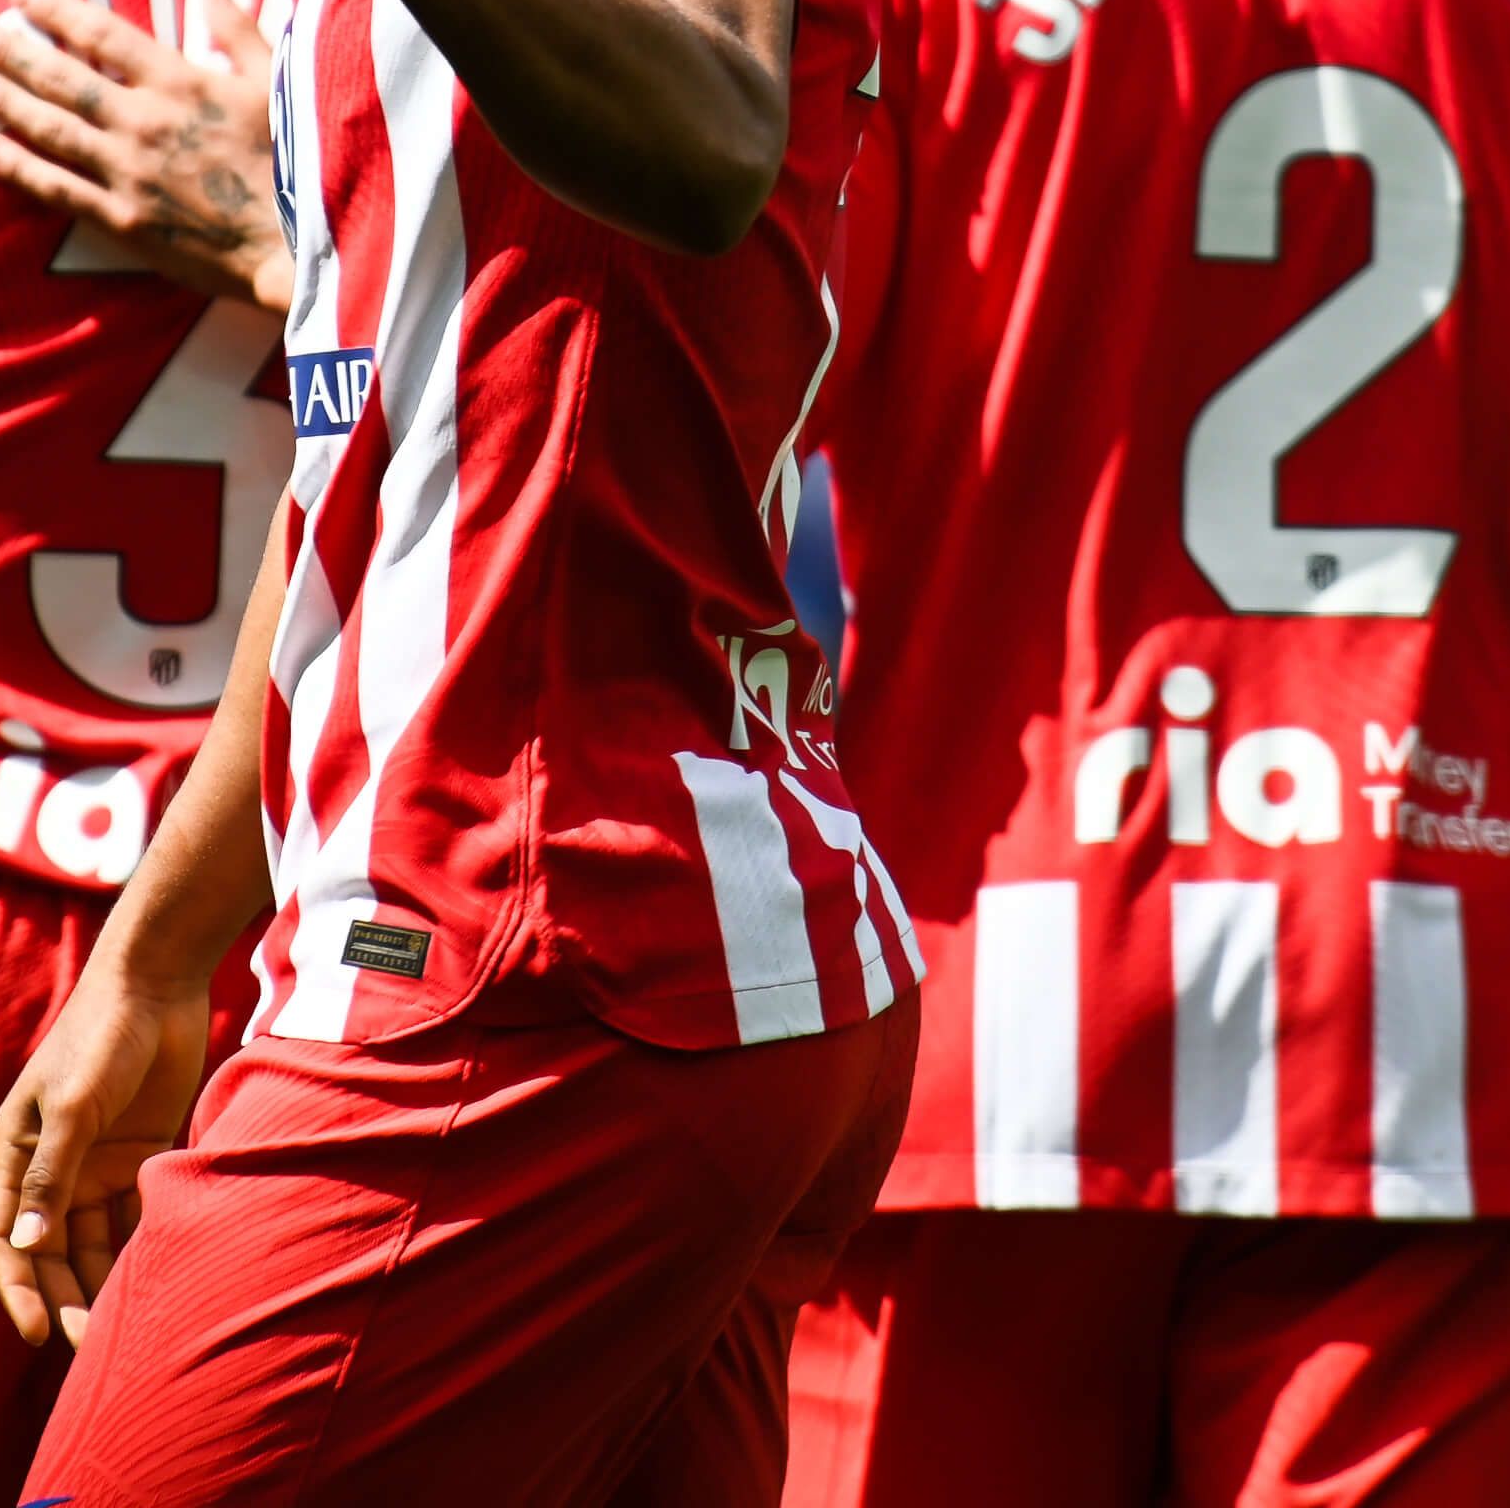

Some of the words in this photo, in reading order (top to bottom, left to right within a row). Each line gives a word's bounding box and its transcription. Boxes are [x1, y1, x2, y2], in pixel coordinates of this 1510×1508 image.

[29, 214, 291, 711] 3
[1182, 64, 1464, 617] 2
[1074, 665, 1343, 848] ria
